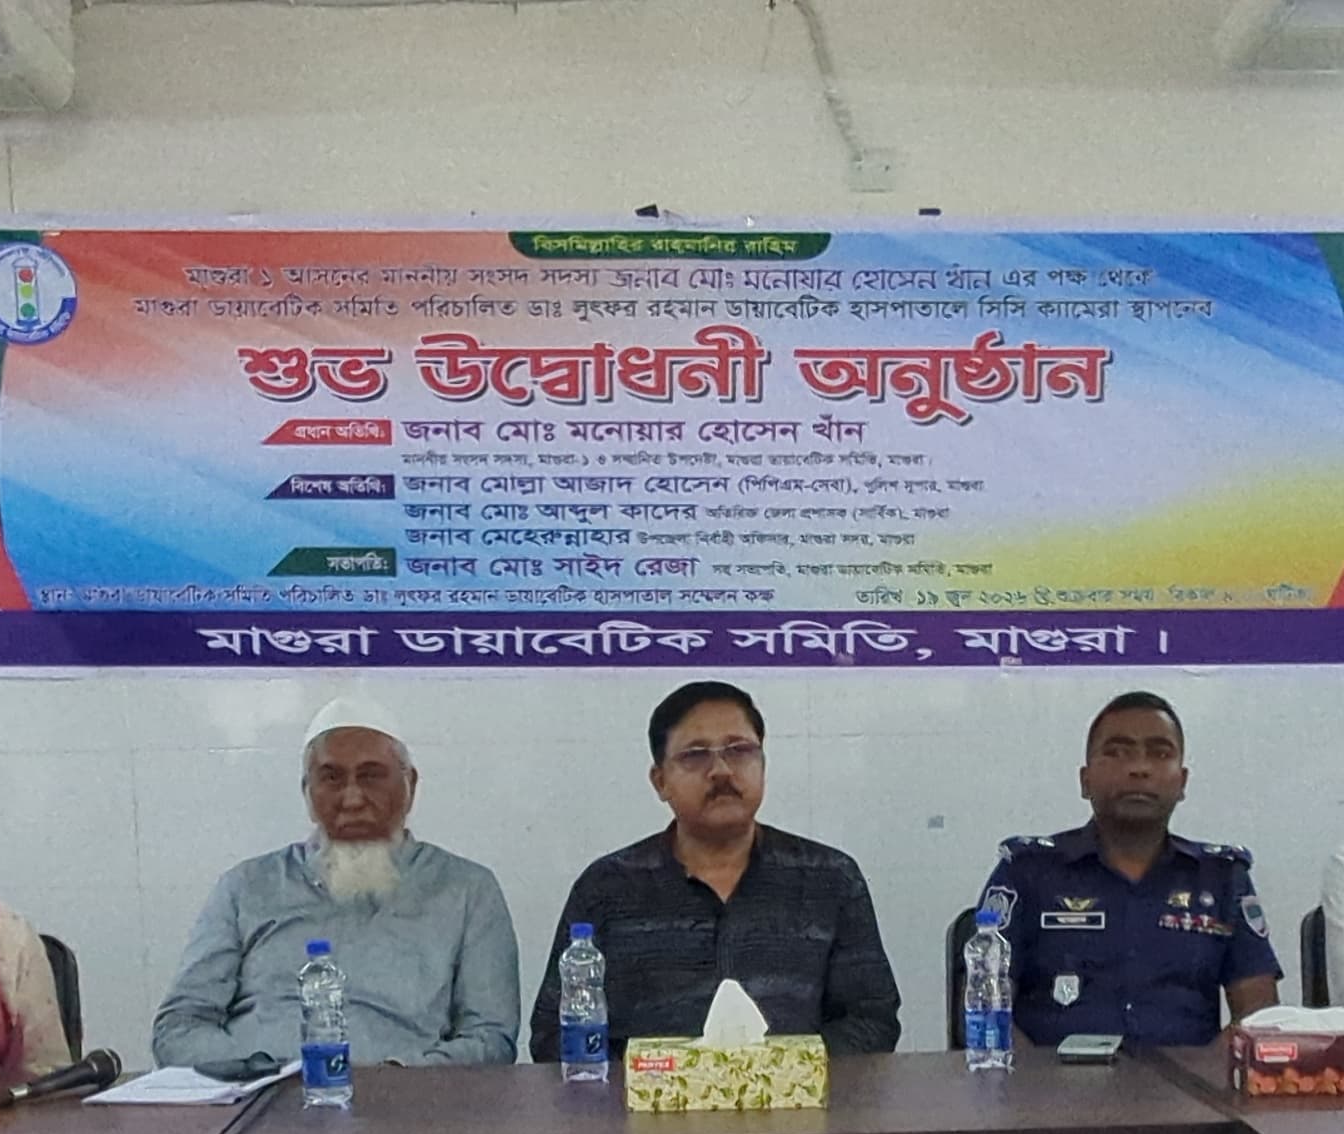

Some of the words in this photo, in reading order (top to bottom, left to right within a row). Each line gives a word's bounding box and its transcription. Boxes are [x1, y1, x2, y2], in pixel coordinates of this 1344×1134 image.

[183, 267, 252, 286] মাগুরা
[261, 269, 273, 287] ১
[282, 267, 369, 286] আসনের
[381, 265, 457, 286] মাননীয়
[469, 267, 528, 287] সংসদ
[540, 268, 599, 287] সদস্য
[608, 268, 679, 289] জনাব
[689, 266, 734, 290] মোঃ
[852, 268, 936, 290] হোসেন
[1003, 269, 1038, 288] এর
[1047, 268, 1087, 287] পক্ষ
[1098, 268, 1153, 287] থেকে
[135, 299, 198, 317] মাগুরা
[335, 294, 399, 317] সমিতি
[411, 294, 515, 318] পরিচালিত
[527, 299, 561, 318] ডাঃ
[572, 299, 636, 322] লুৎফর
[647, 300, 719, 319] রহমান
[726, 294, 840, 320] ডায়াবেটিক
[850, 300, 968, 320] হাসপাতালে
[979, 295, 1025, 319] সিসি
[1037, 300, 1118, 320] ক্যামেরা
[236, 345, 393, 403] শুভ
[414, 323, 771, 408] উদ্বোধনী
[792, 329, 1113, 426] অনুষ্ঠান
[295, 425, 331, 440] প্রধান
[401, 419, 484, 442] জনাব
[496, 418, 555, 442] মোঃ
[566, 419, 685, 443] মনোয়ার
[698, 418, 801, 444] হোসেন
[812, 414, 868, 444] খাঁন
[402, 476, 472, 494] জনাব
[481, 476, 546, 495] মোল্লা
[552, 476, 637, 494] আজাদ
[644, 476, 731, 495] হোসেন
[403, 503, 471, 523] জনাব
[481, 503, 529, 521] মোঃ
[536, 503, 608, 525] আব্দুল
[619, 503, 698, 521] কাদের
[405, 528, 476, 546] জনাব
[481, 528, 632, 548] মেহেরুন্নাহার
[407, 557, 478, 577] জনাব
[489, 556, 542, 577] মোঃ
[553, 553, 626, 577] সাইদ
[634, 557, 701, 577] রেজা
[447, 589, 499, 606] রহমান
[593, 588, 671, 606] হাসপাতাল
[195, 625, 381, 656] মাগুরা
[394, 619, 714, 656] ডায়াবেটিক
[727, 620, 933, 661] সমিতি,
[956, 625, 1136, 656] মাগুরা
